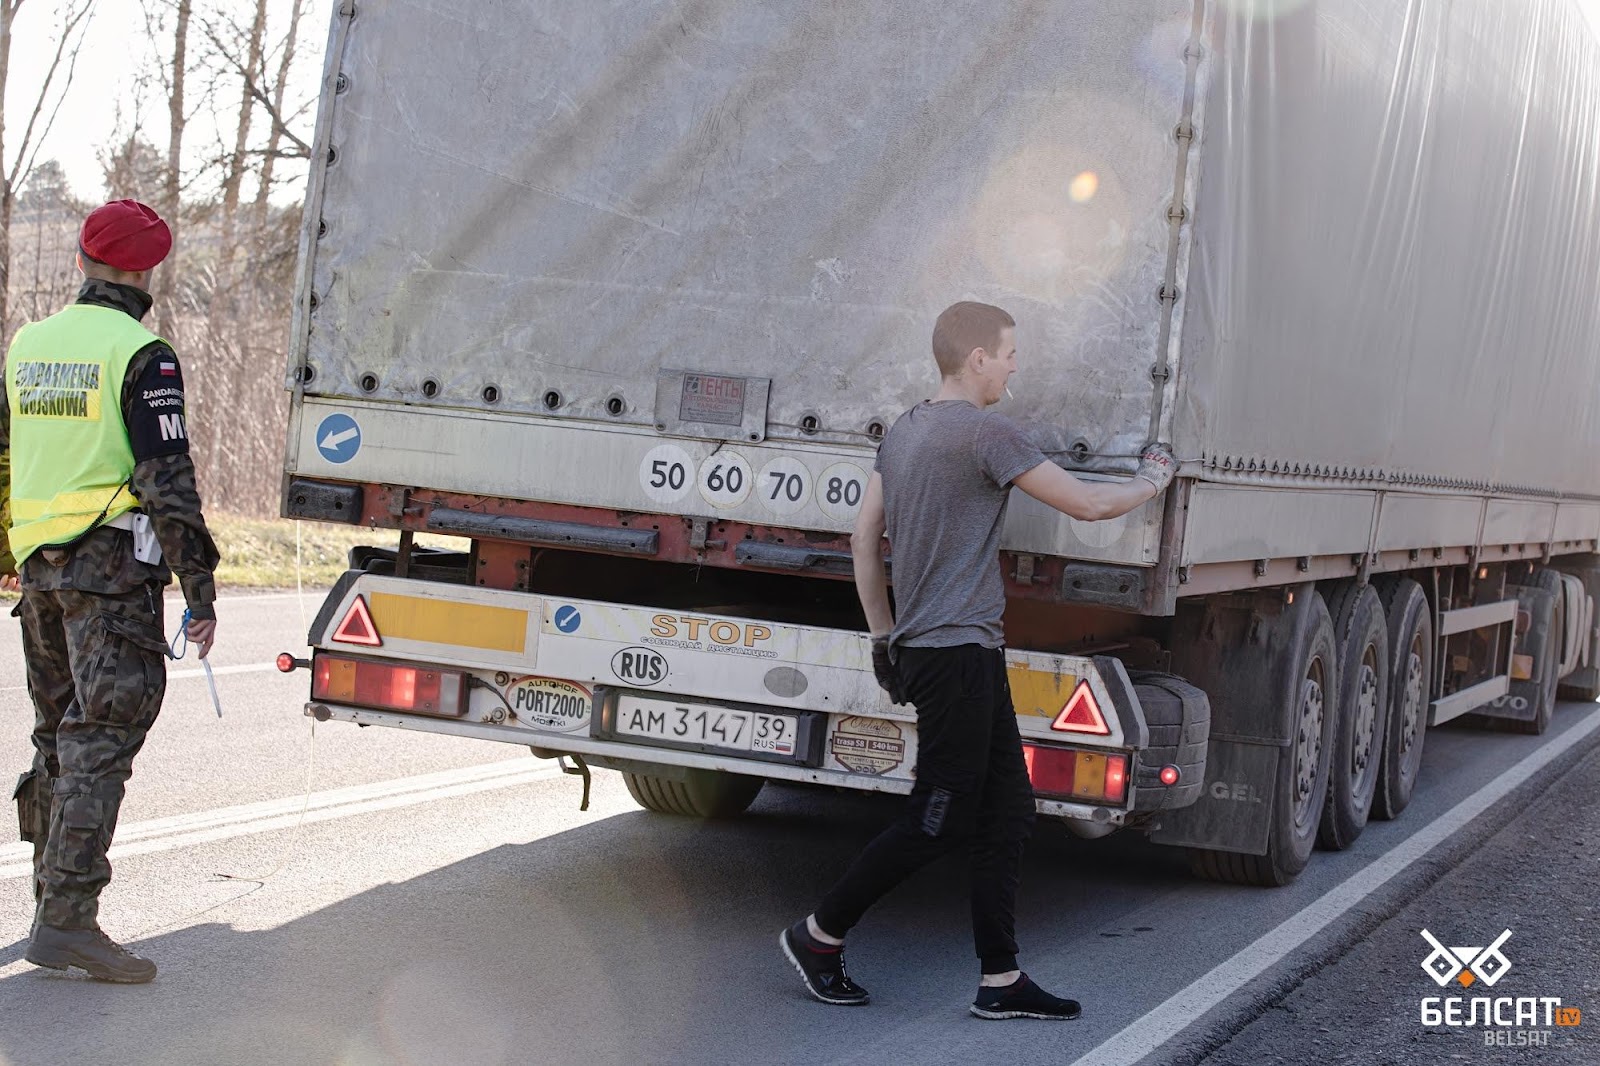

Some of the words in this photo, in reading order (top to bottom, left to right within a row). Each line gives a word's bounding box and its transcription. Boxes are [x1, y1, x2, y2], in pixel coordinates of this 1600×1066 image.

[19, 388, 88, 417] WOJSKOWA
[650, 460, 686, 490] 50
[707, 464, 743, 493] 60
[769, 471, 804, 502] 70
[826, 477, 862, 507] 80
[650, 614, 772, 648] STOP
[640, 635, 703, 650] СОБЛЮДАЙ
[706, 643, 779, 659] ДИСТАНЦИЮ
[620, 652, 662, 681] RUS
[527, 680, 579, 695] AUTOHOF
[515, 687, 585, 720] PORT2000
[757, 715, 786, 740] 39
[753, 740, 775, 750] RUS
[872, 741, 886, 749] 540
[886, 743, 899, 751] km
